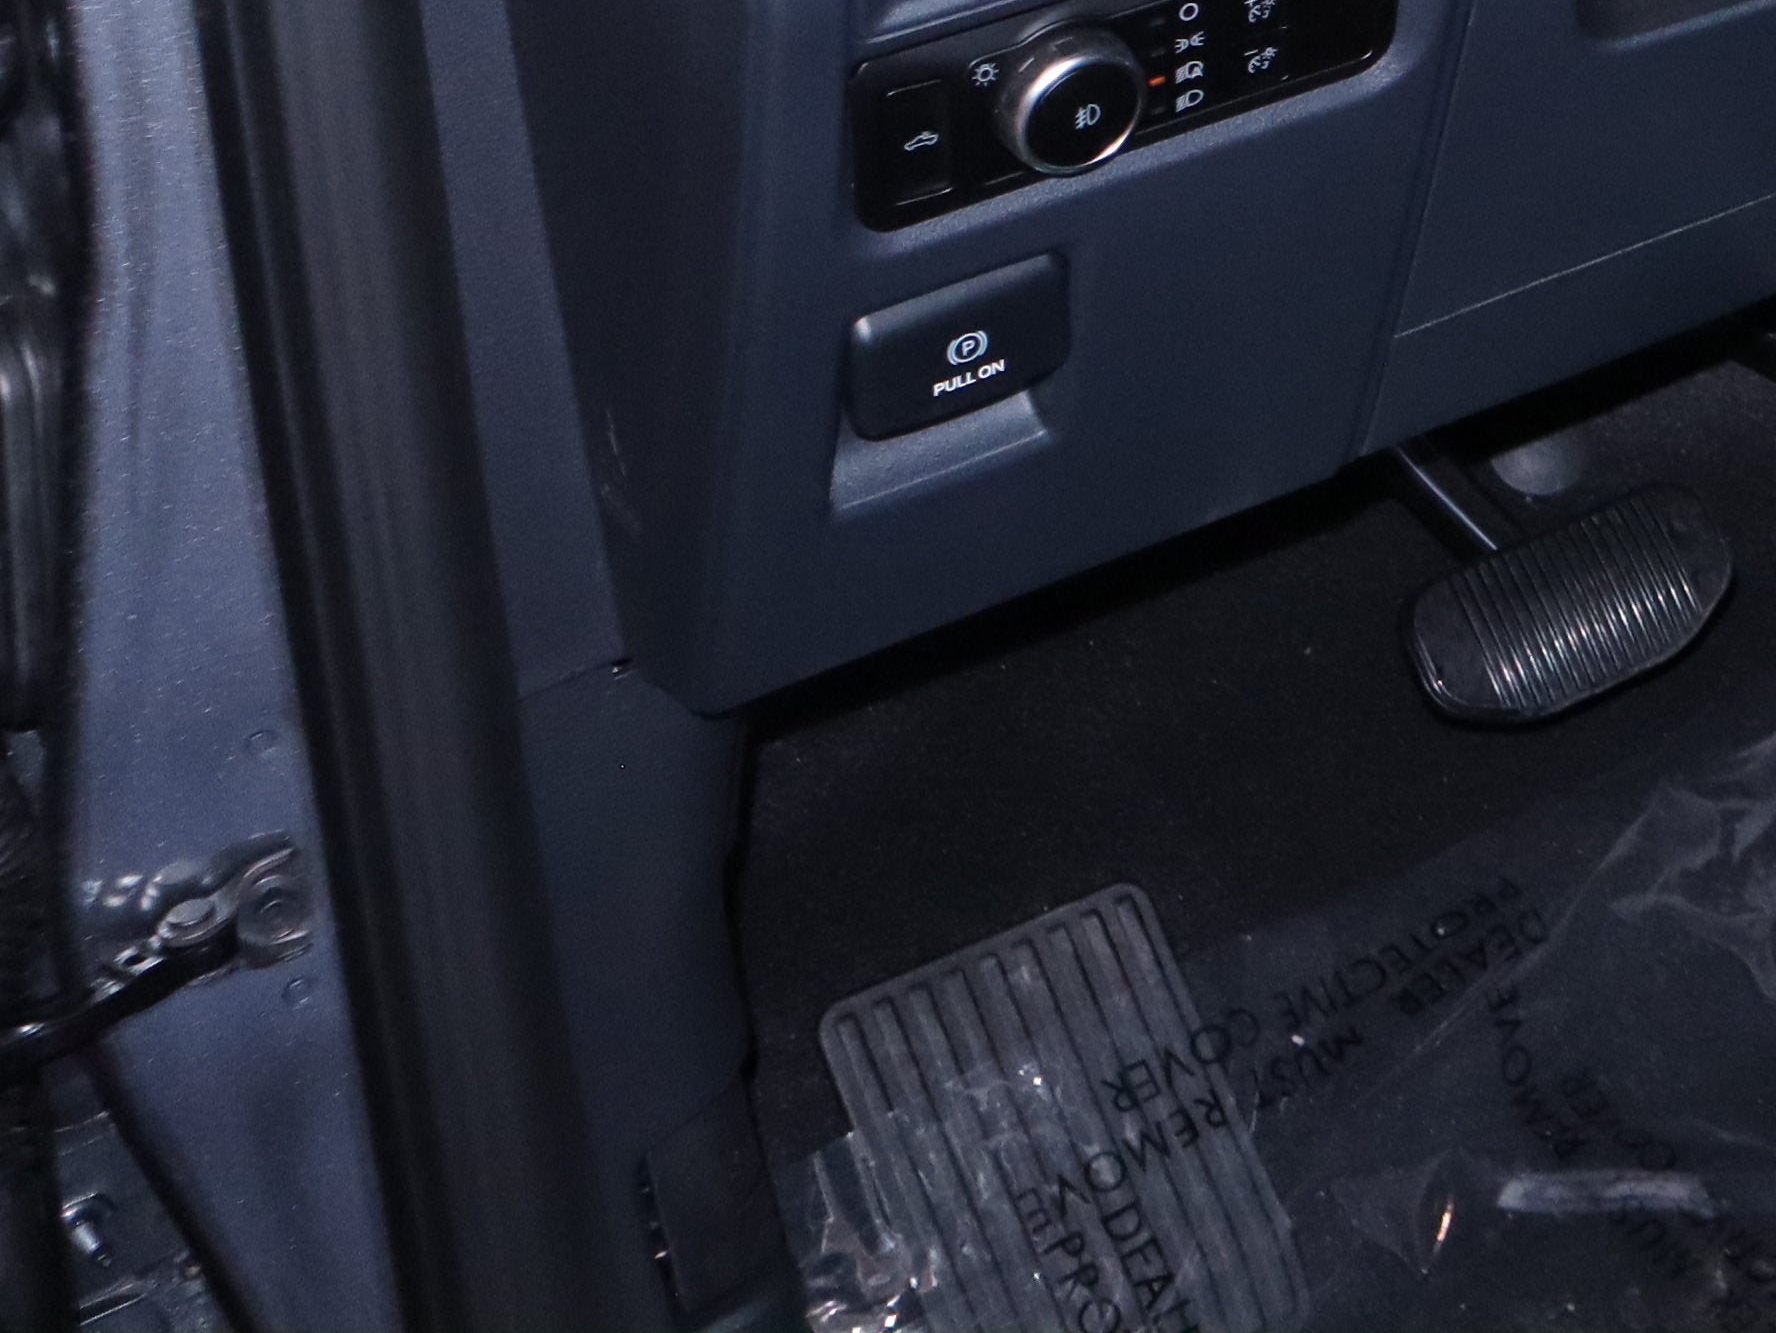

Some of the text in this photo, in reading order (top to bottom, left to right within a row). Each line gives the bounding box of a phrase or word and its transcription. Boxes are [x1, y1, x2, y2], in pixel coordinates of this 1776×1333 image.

[933, 358, 1005, 397] PULL ON
[1101, 876, 1522, 1113] PROTECTIVE COVER
[1390, 908, 1548, 1016] DEALER
[1253, 1024, 1363, 1109] MUST
